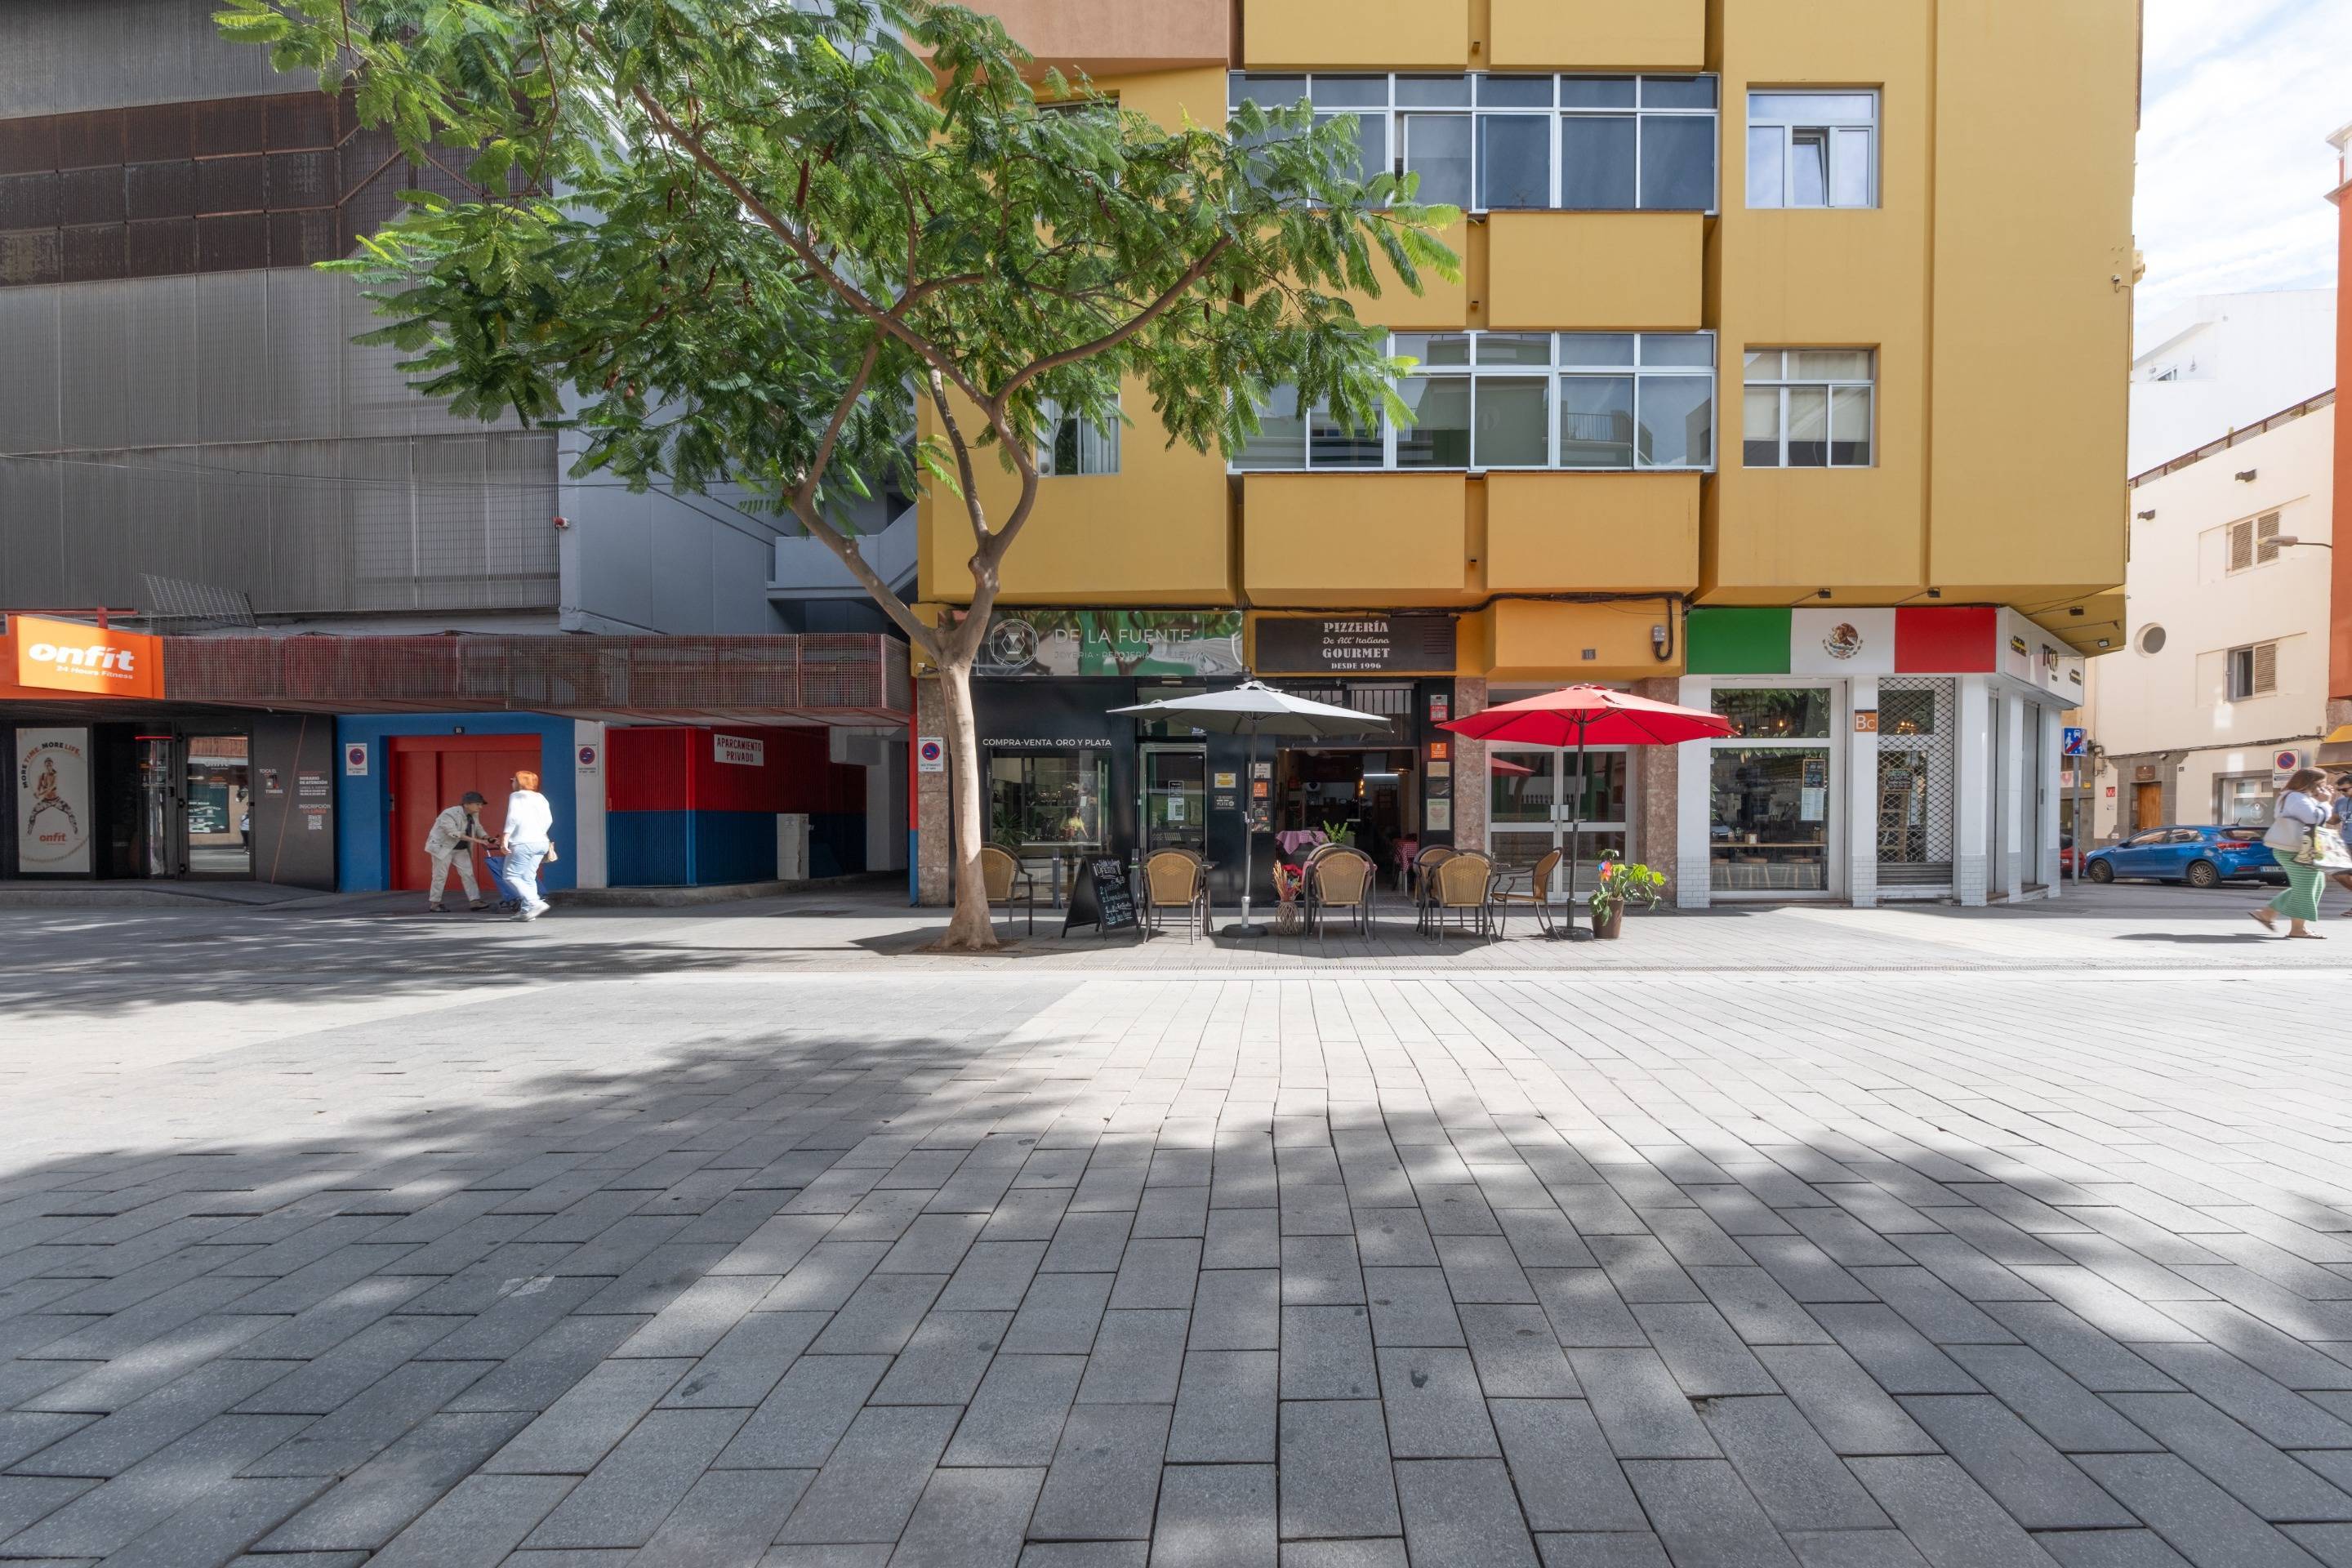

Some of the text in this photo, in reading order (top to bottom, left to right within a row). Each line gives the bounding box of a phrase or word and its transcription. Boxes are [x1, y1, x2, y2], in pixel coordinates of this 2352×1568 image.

[1324, 621, 1388, 632] PIZZERÍA
[1055, 629, 1191, 644] DE LA FUENTE
[29, 643, 135, 671] onfit
[1322, 648, 1390, 658] GOURMET
[101, 670, 133, 679] Fitness
[1855, 715, 1876, 730] Bc
[716, 737, 762, 752] APARCAMIENTO
[982, 738, 1053, 746] COMPRA-VENTA
[1055, 738, 1076, 746] ORO
[1077, 738, 1084, 746] Y
[726, 750, 754, 762] PRIVADO
[20, 764, 29, 789] MORE
[39, 832, 66, 842] onfit
